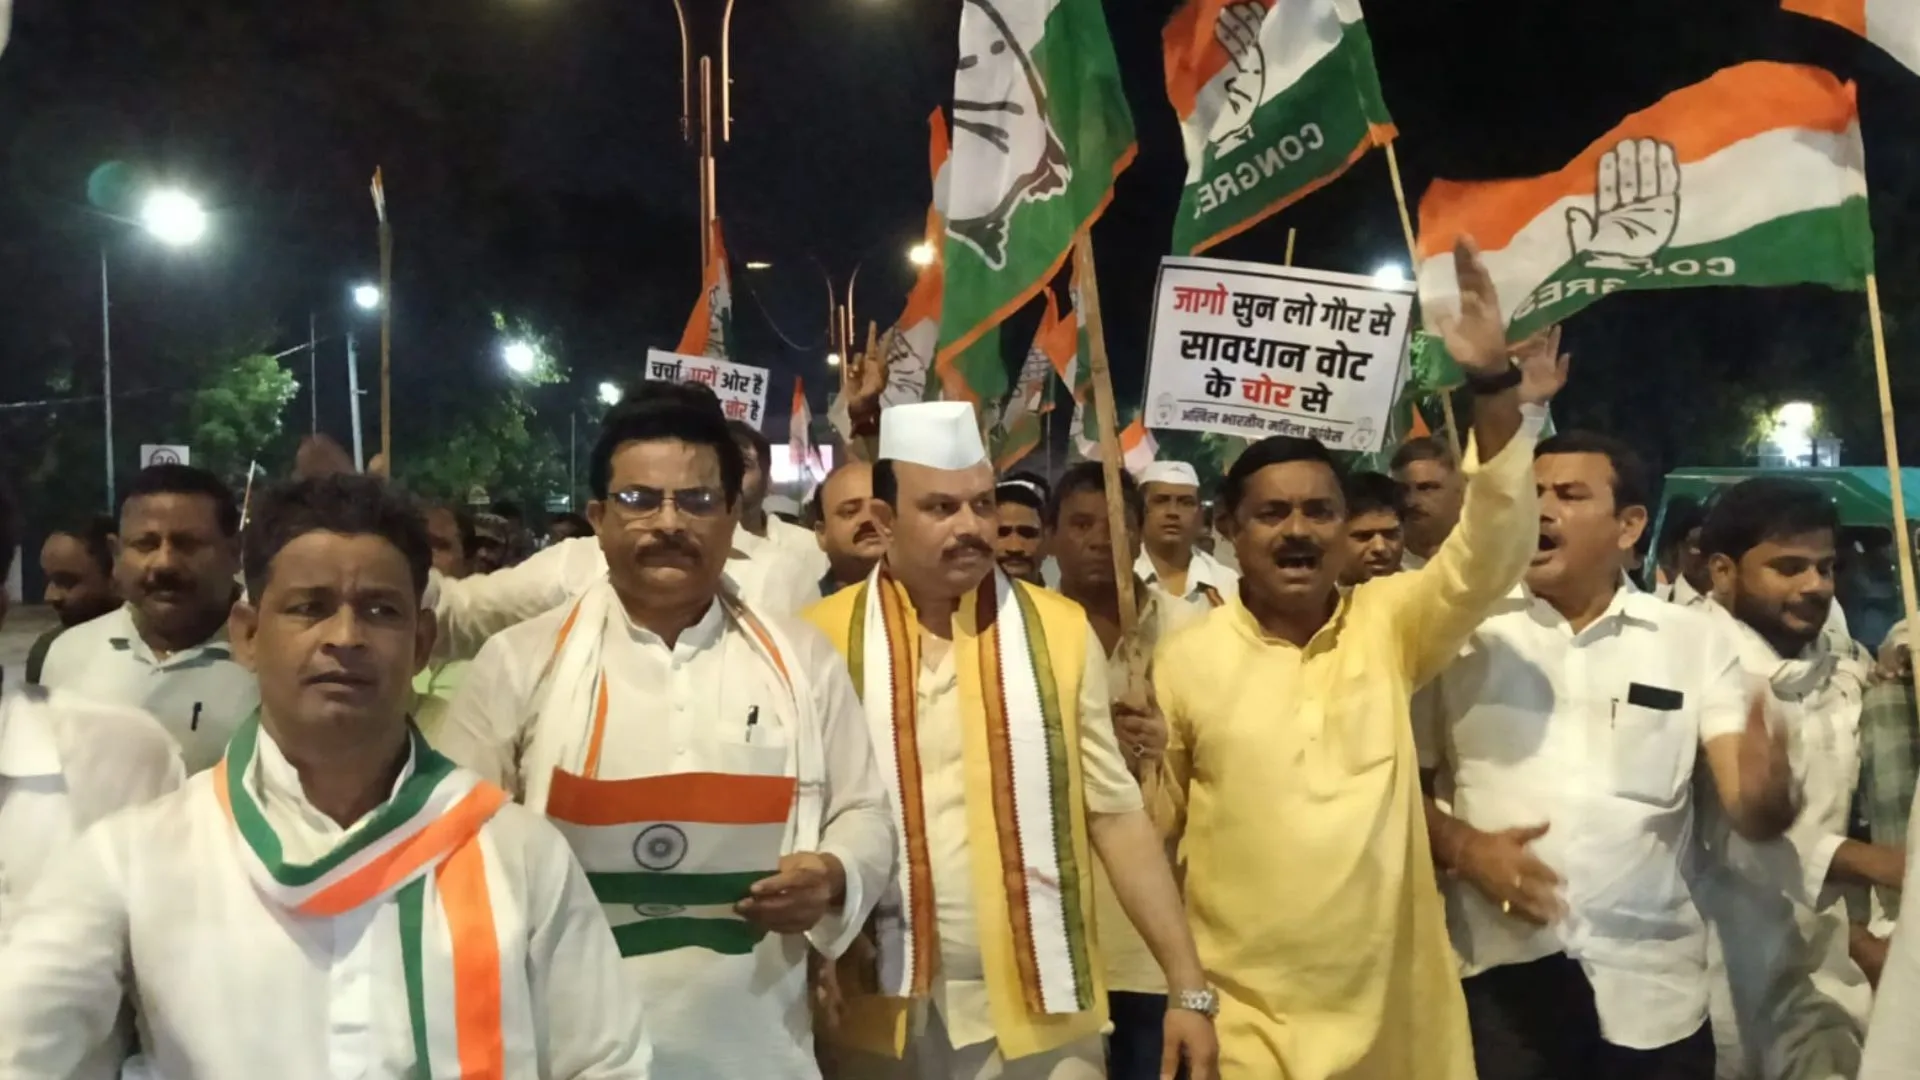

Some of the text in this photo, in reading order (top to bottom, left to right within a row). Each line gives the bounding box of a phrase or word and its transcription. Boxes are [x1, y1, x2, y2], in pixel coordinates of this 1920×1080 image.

[1173, 283, 1396, 337] जागो सुन लो गौर से
[1179, 330, 1373, 381] सावधान वोट
[651, 360, 682, 380] चर्चा
[721, 369, 750, 393] ओर
[752, 373, 763, 395] है
[1204, 367, 1333, 414] के चोर से
[750, 400, 761, 421] है
[1221, 411, 1265, 430] भारतीय
[1267, 419, 1306, 436] महिला
